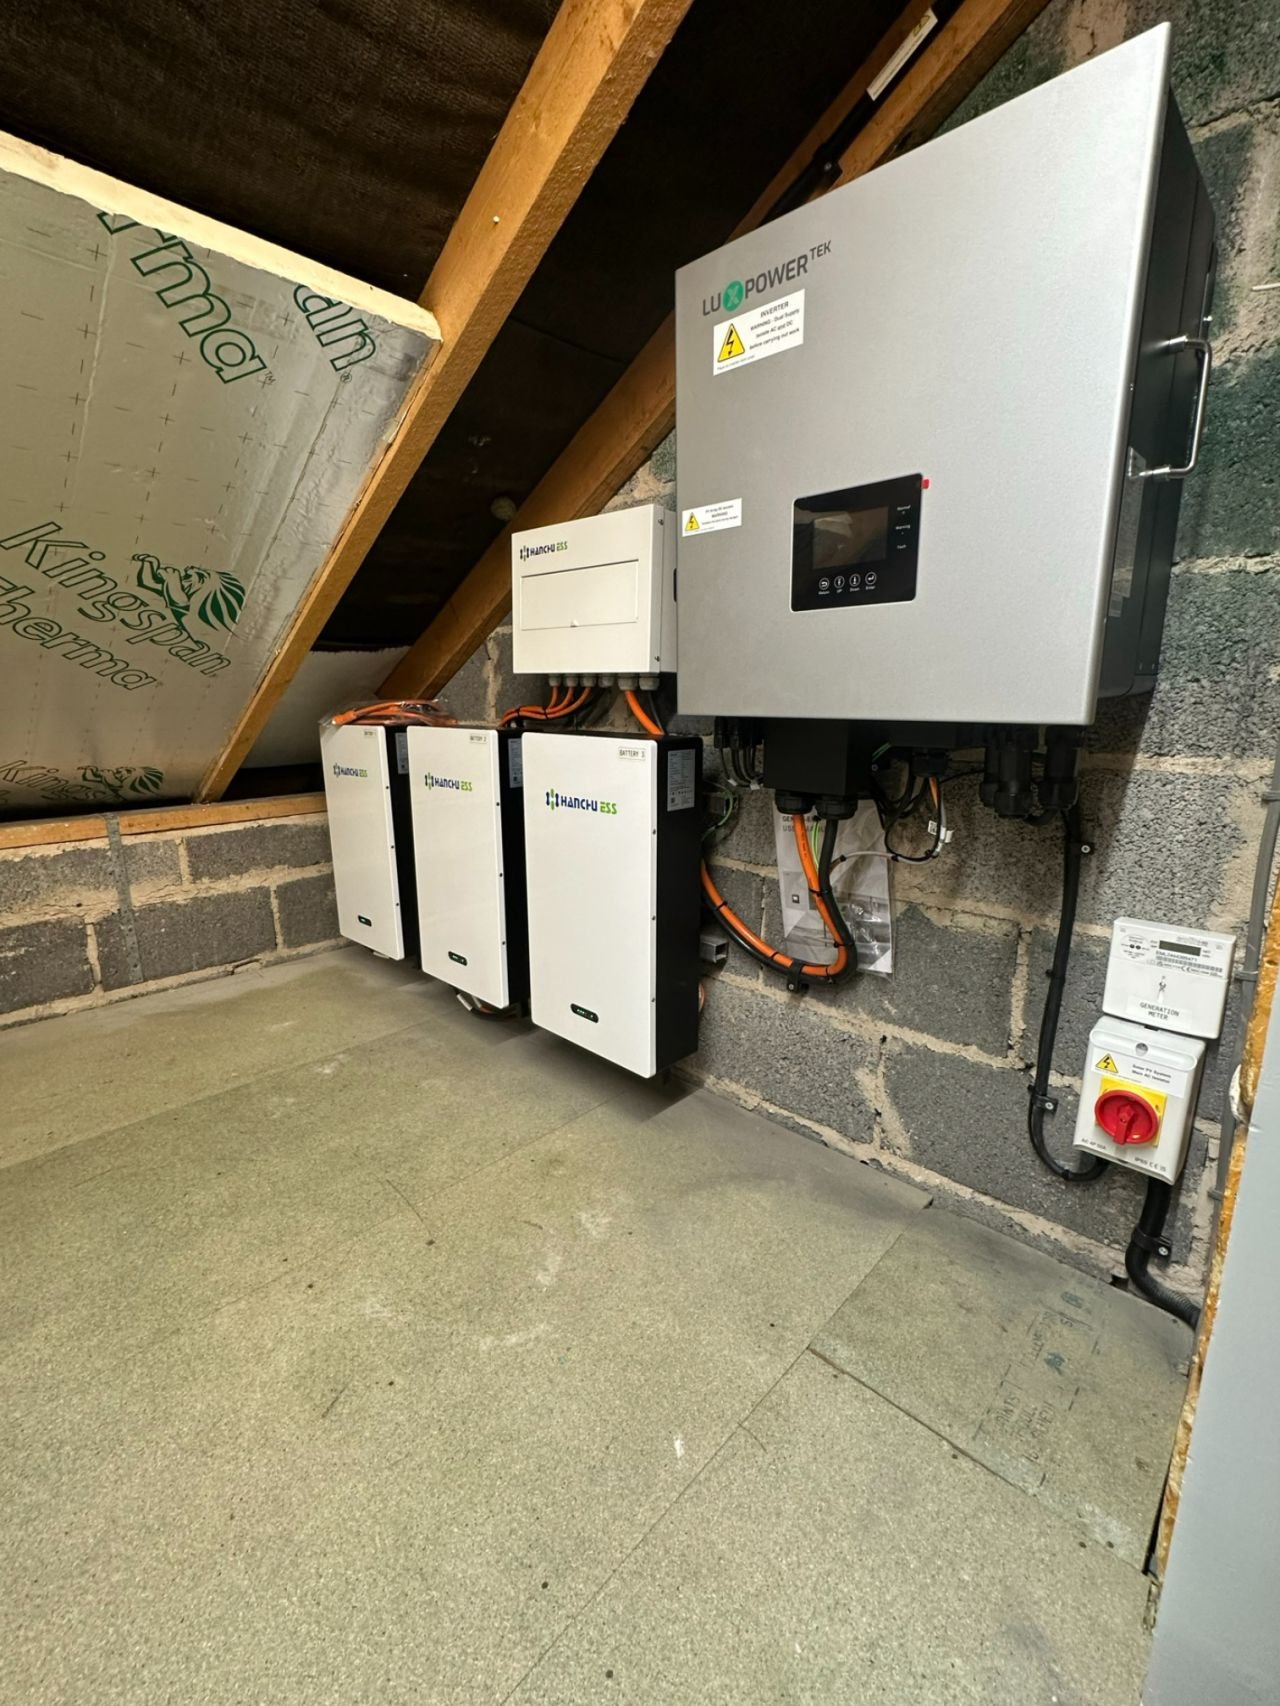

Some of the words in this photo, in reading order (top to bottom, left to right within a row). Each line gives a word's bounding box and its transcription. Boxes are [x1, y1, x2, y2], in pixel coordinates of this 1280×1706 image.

[760, 301, 789, 318] INVERTER
[770, 325, 777, 333] AC
[777, 321, 785, 331] and
[530, 543, 556, 557] HANCHU
[556, 541, 568, 552] ESS
[0, 521, 231, 676] Kingspan
[0, 576, 157, 690] herma
[619, 748, 639, 758] BATTERY
[435, 777, 460, 790] HANCHU
[461, 781, 473, 792] ESS
[560, 795, 598, 812] HANCHU
[600, 801, 617, 815] ESS
[1140, 1001, 1179, 1016] GENERATION
[1148, 1010, 1168, 1020] METER
